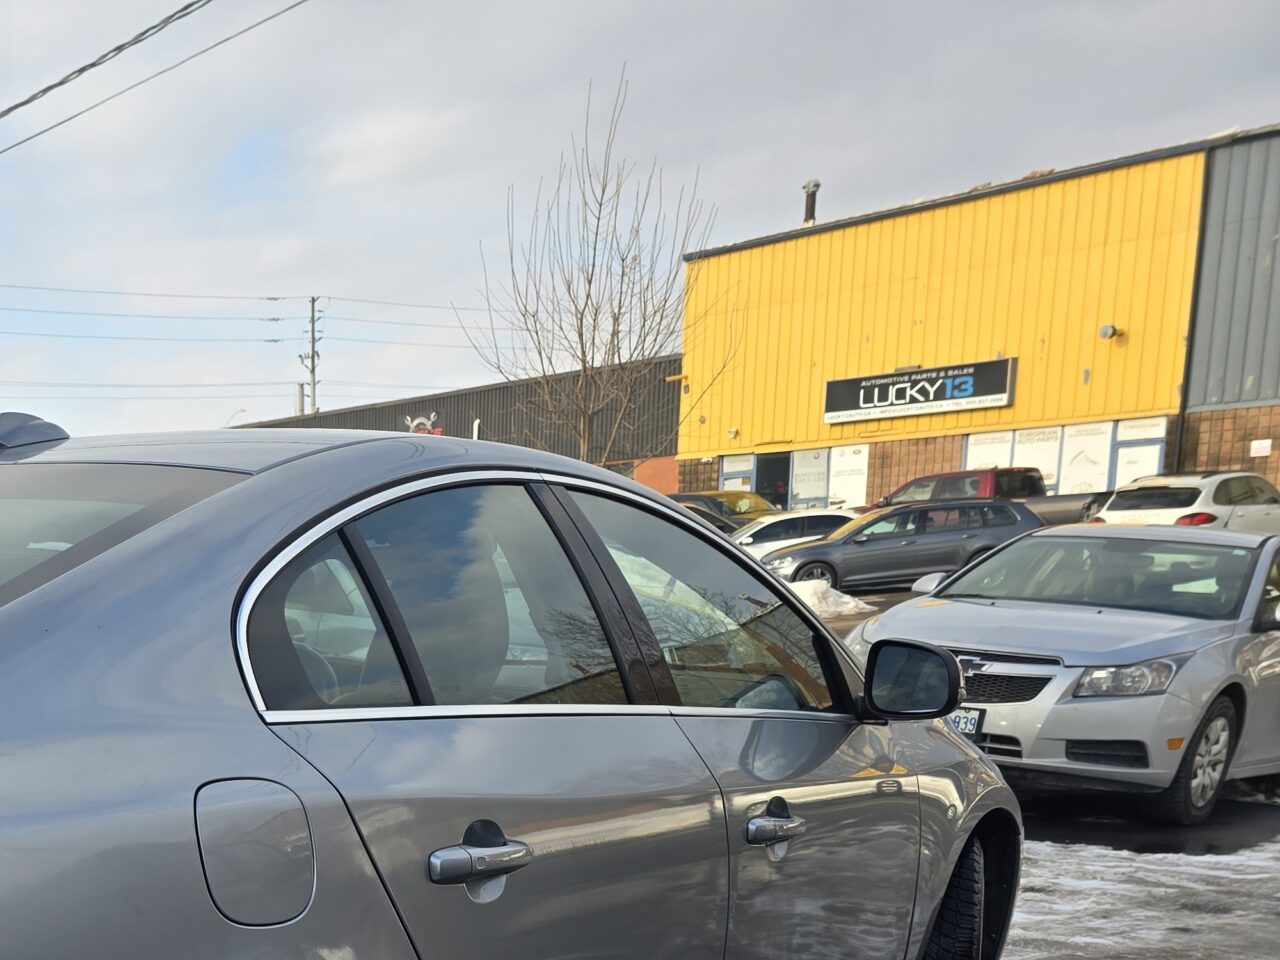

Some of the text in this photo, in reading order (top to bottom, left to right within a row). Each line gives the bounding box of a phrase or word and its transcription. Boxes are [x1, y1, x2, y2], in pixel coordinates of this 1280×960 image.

[861, 375, 909, 386] AUTOMOTIVE
[911, 371, 937, 380] PARTS
[947, 367, 974, 376] SALES
[860, 379, 943, 408] LUCKY
